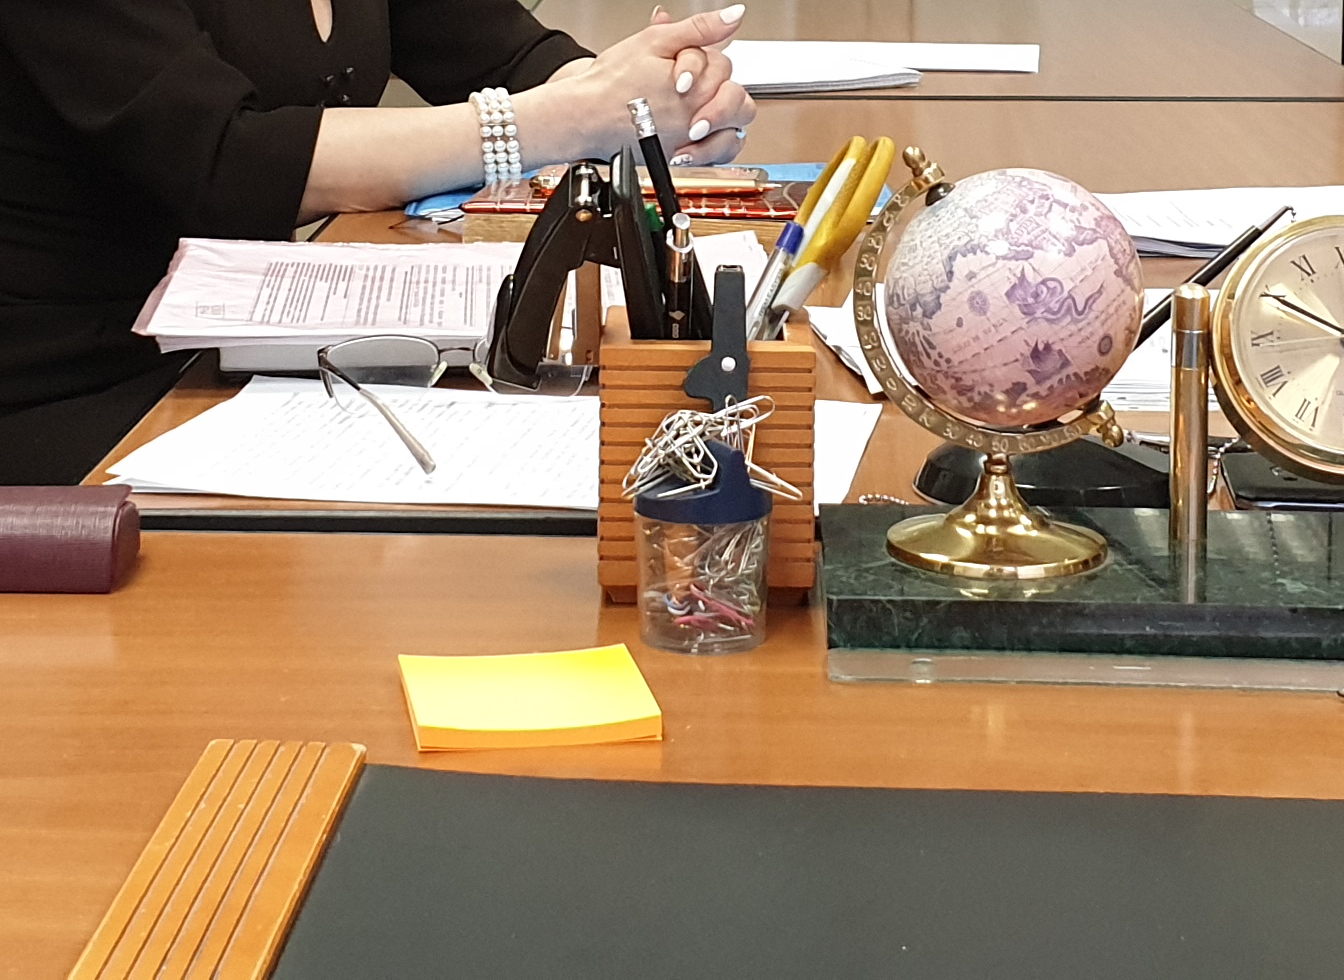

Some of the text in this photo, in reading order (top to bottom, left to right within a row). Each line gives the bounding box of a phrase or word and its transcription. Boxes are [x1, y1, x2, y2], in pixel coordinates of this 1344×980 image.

[1290, 254, 1316, 280] XI
[1260, 365, 1289, 399] VIII
[1295, 398, 1319, 431] VII
